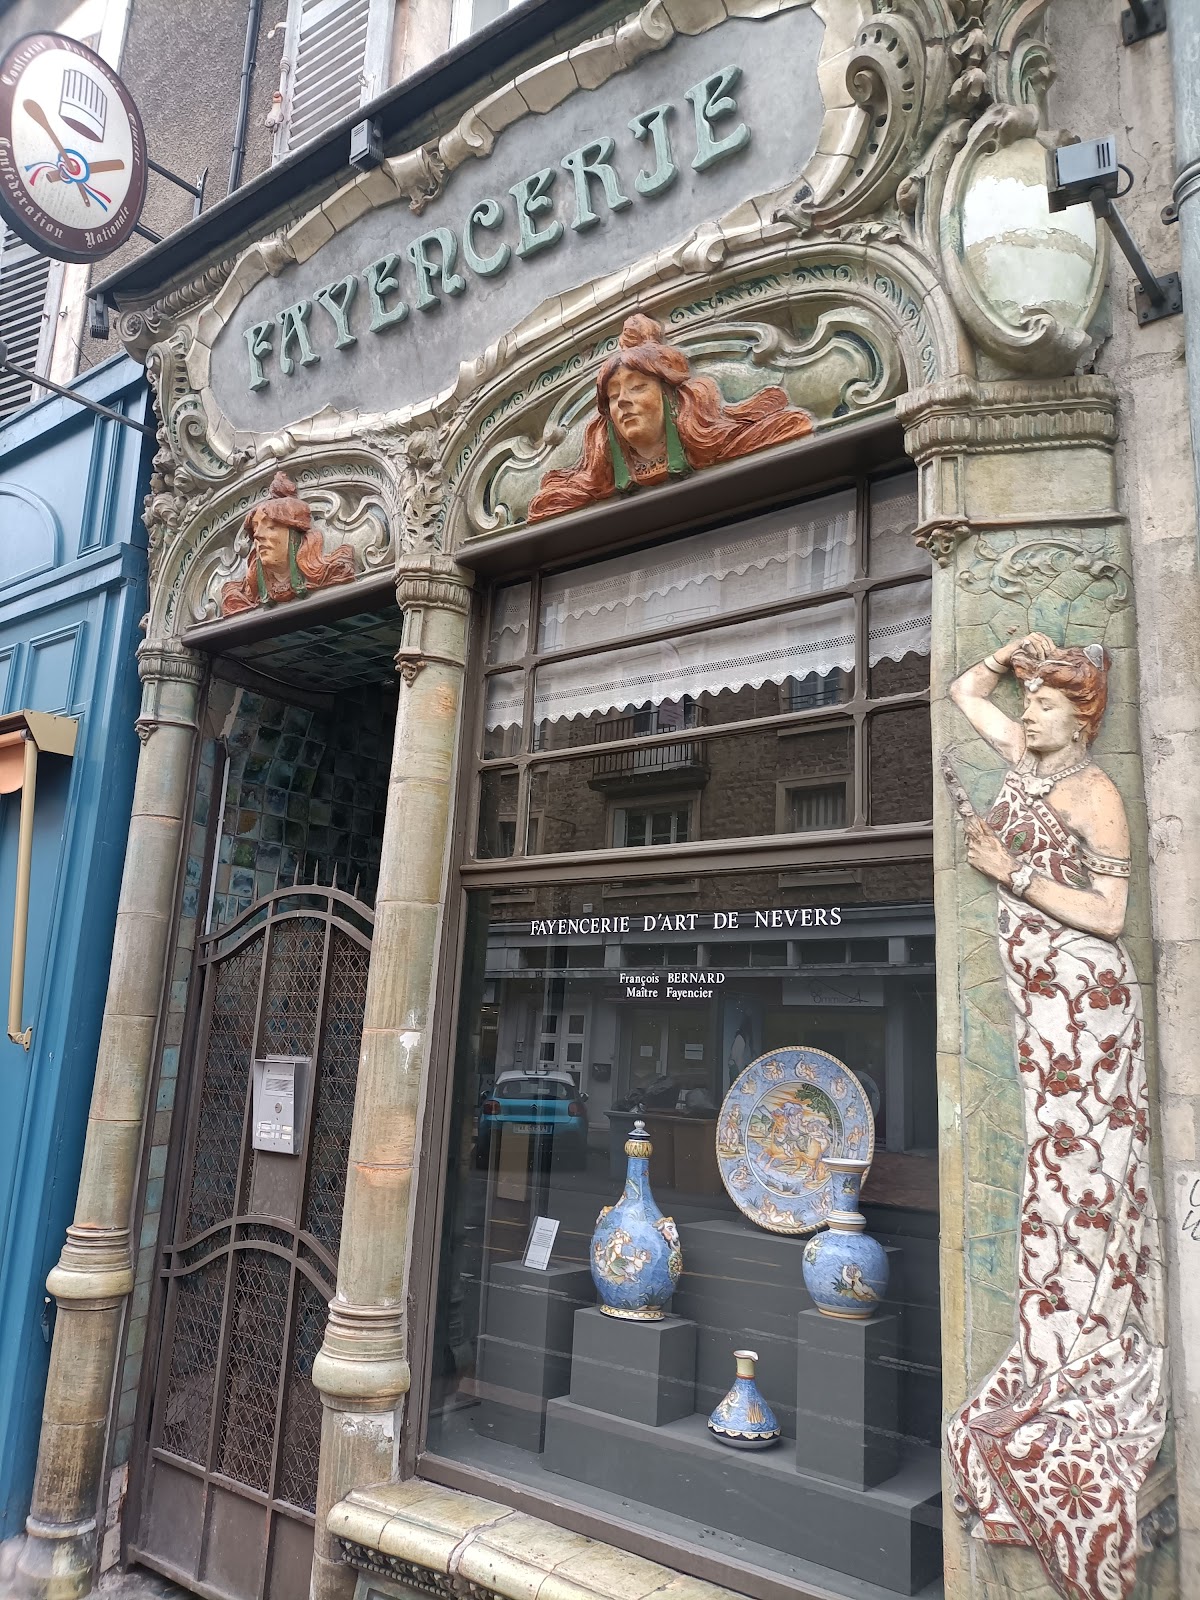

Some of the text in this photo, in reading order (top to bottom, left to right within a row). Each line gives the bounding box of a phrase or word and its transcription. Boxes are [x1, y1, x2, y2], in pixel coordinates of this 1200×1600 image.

[1, 40, 47, 86] Confiseur
[84, 205, 130, 249] Nationale
[530, 907, 842, 936] FAYENCERIE D'ART DE NEVERS
[619, 972, 725, 987] François BERNARD
[626, 987, 713, 1000] Maître Fayencier
